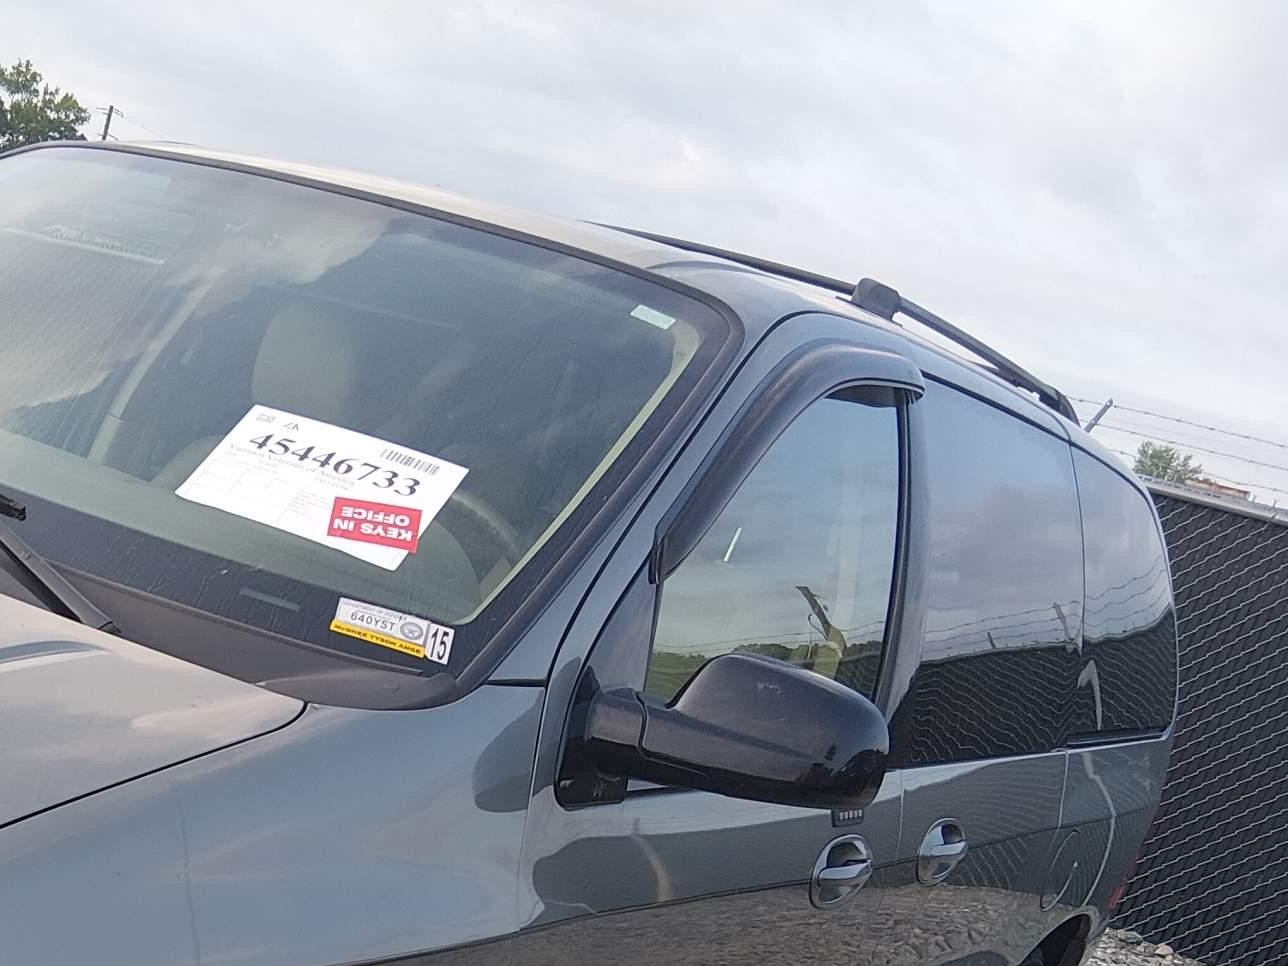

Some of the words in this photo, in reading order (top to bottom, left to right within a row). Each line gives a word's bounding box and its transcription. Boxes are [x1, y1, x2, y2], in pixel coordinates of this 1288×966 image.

[249, 433, 421, 497] 45446733
[332, 518, 355, 532] IN
[340, 505, 410, 527] OFFICE
[359, 522, 413, 543] KEYS
[350, 611, 397, 632] 640YST
[369, 631, 398, 647] TYSON
[431, 627, 450, 661] 15
